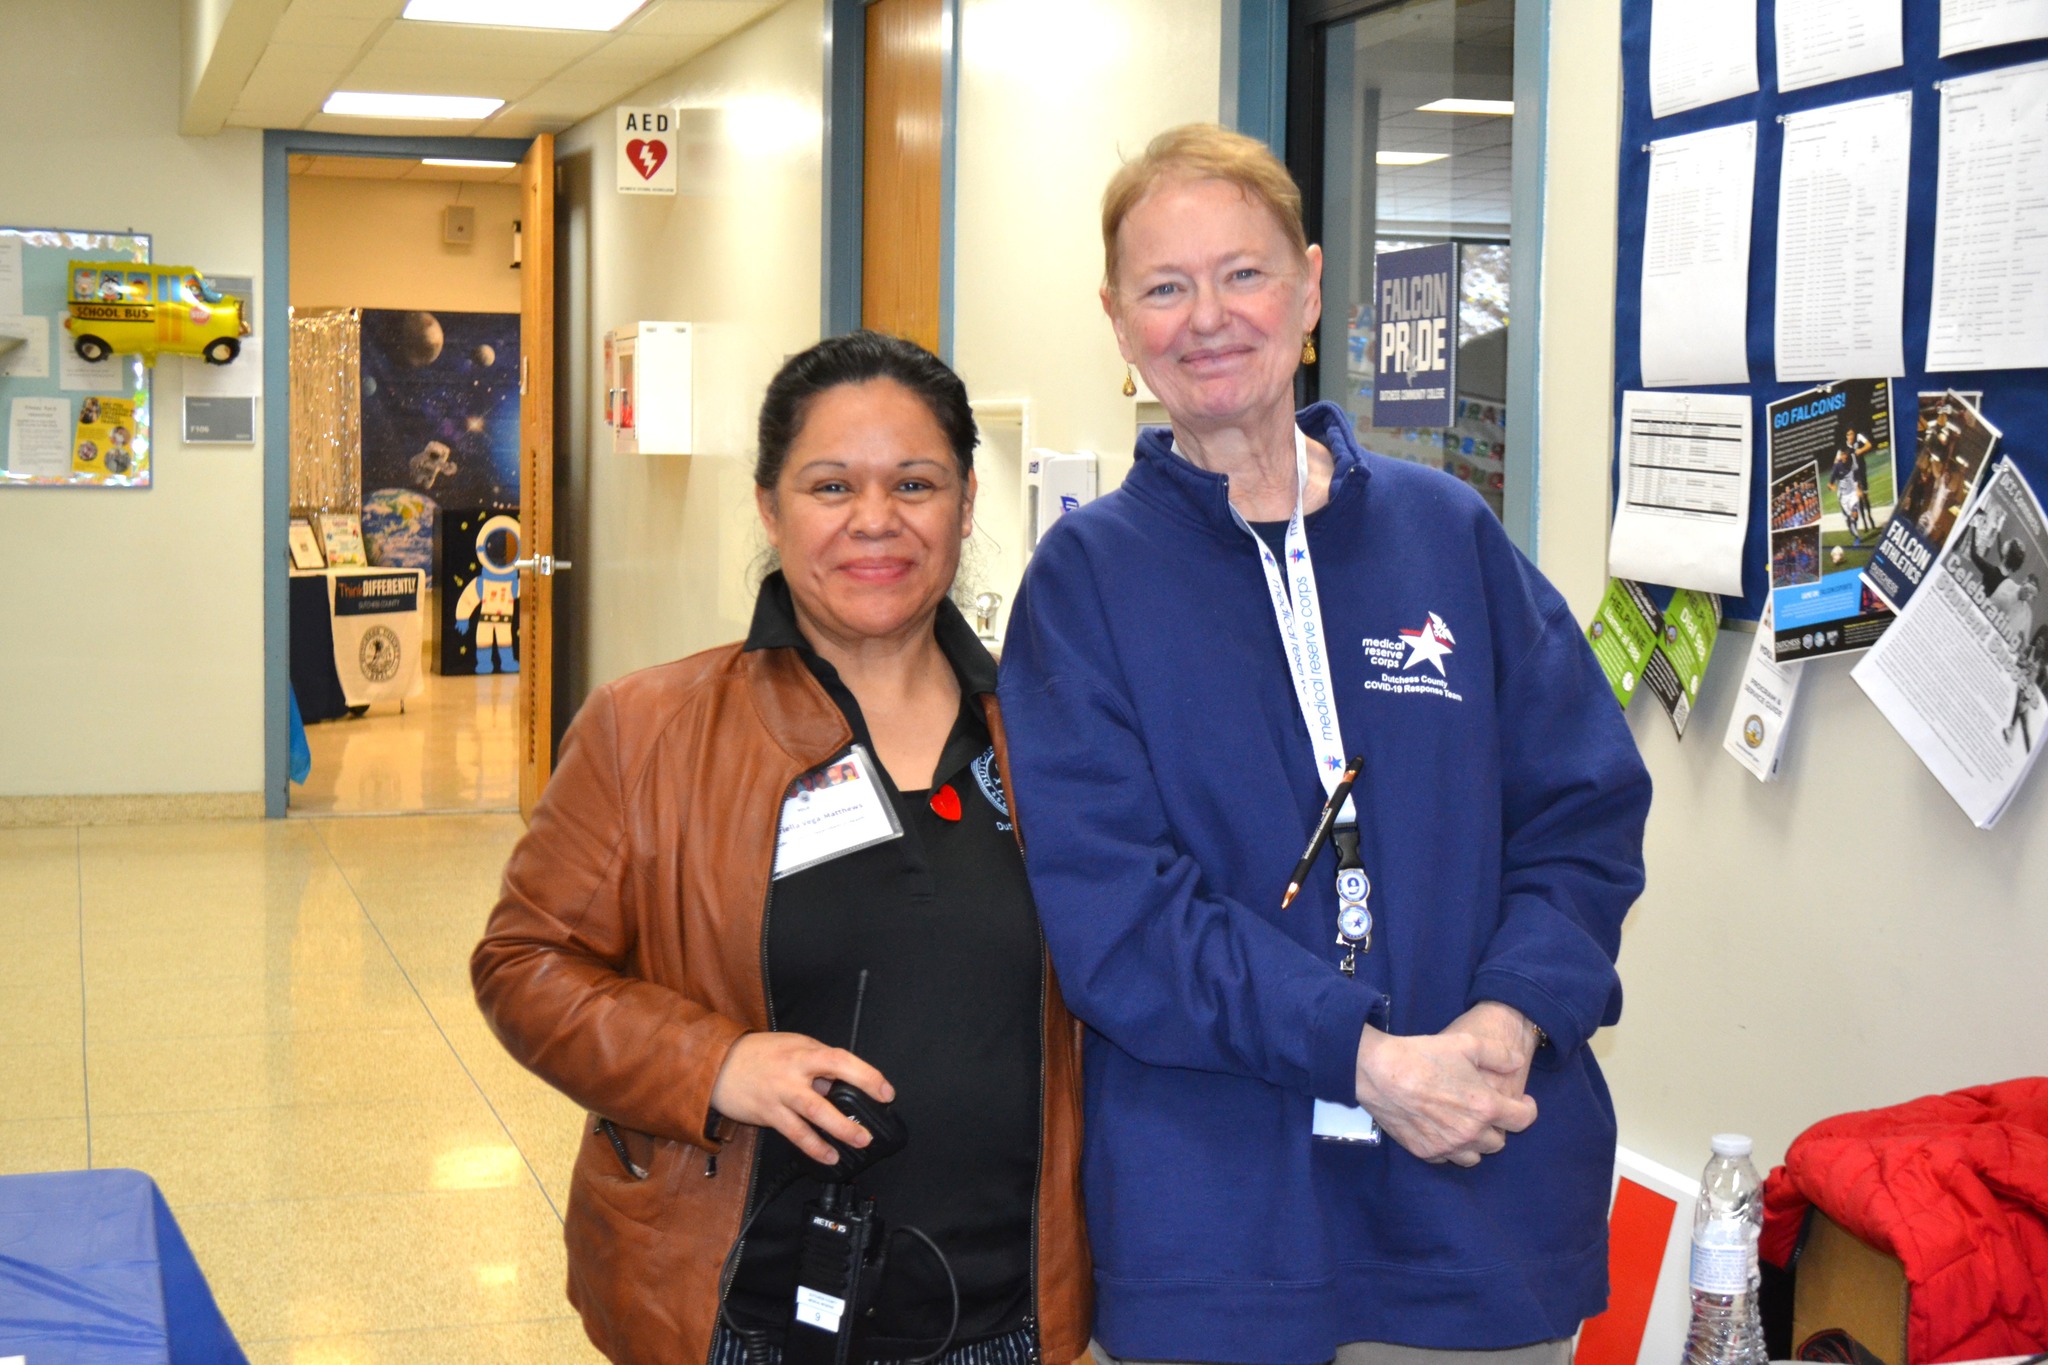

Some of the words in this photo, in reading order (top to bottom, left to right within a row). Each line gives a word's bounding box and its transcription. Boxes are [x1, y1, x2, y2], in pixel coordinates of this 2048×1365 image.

[626, 113, 668, 132] AED
[77, 306, 120, 317] SCHOOL
[125, 308, 149, 318] BUS
[1382, 272, 1447, 322] FALCON
[1380, 318, 1447, 374] PRIDE
[1774, 411, 1790, 429] GO
[1790, 392, 1846, 424] FALCONS!
[1879, 539, 1922, 585] ATHLETICS
[1886, 519, 1932, 571] FALCON
[1297, 576, 1313, 618] corps
[1936, 570, 1991, 641] Student
[1945, 552, 2022, 651] Celebrating
[1610, 593, 1646, 651] HELPLINE
[1680, 607, 1698, 638] Dial
[1303, 621, 1322, 675] reserve
[1362, 638, 1406, 651] medical
[1365, 647, 1404, 659] reserve
[1370, 657, 1400, 669] corps
[1364, 681, 1403, 693] COVID-19
[1404, 684, 1443, 696] Response
[1444, 689, 1463, 702] Team
[1382, 673, 1420, 684] Dutchess
[1421, 675, 1448, 689] County
[1309, 678, 1333, 741] medical
[823, 803, 863, 818] Matthews
